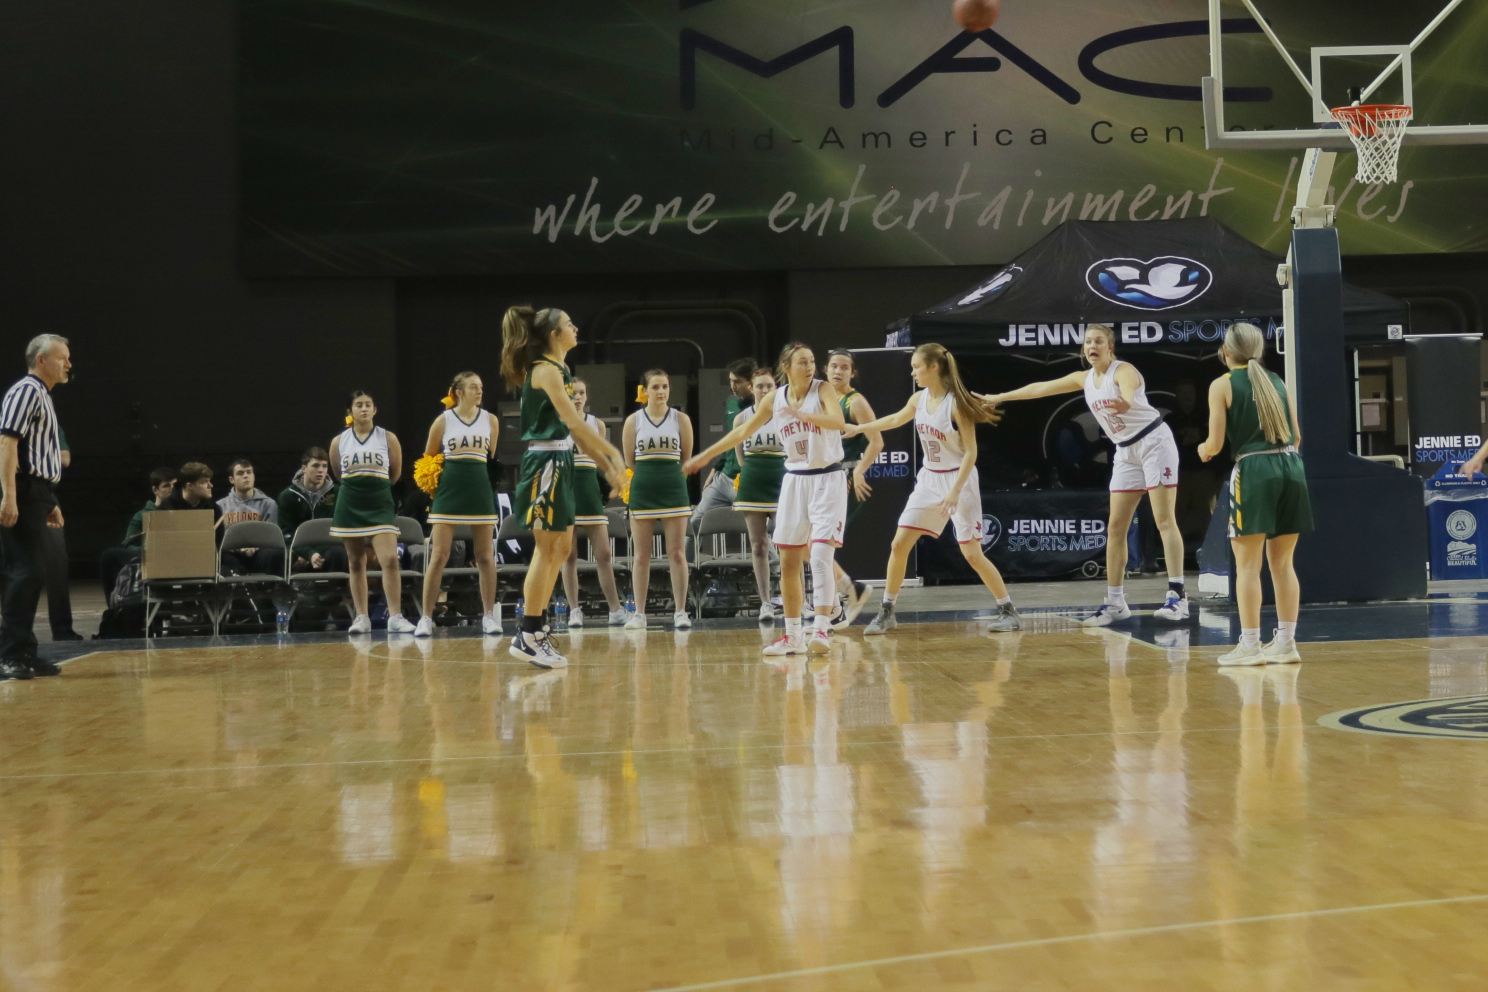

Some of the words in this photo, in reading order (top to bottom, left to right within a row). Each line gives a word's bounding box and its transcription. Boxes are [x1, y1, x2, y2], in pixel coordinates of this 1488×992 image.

[680, 123, 1049, 153] Mid-America
[532, 176, 720, 244] where
[768, 158, 1234, 240] entertainment
[1121, 321, 1164, 343] ED
[447, 435, 490, 451] SAHS
[637, 439, 679, 451] SAHS
[1415, 435, 1461, 449] JENNIE
[1464, 435, 1481, 447] ED
[795, 439, 810, 463] 4
[890, 451, 909, 464] ED
[922, 440, 941, 463] 12
[1416, 449, 1455, 463] SPORTS
[343, 452, 384, 469] SAHS
[882, 464, 910, 478] MED
[1008, 519, 1076, 534] JENNIE
[1081, 519, 1106, 534] ED
[1008, 535, 1067, 551] SPORTS
[1069, 535, 1107, 551] MED
